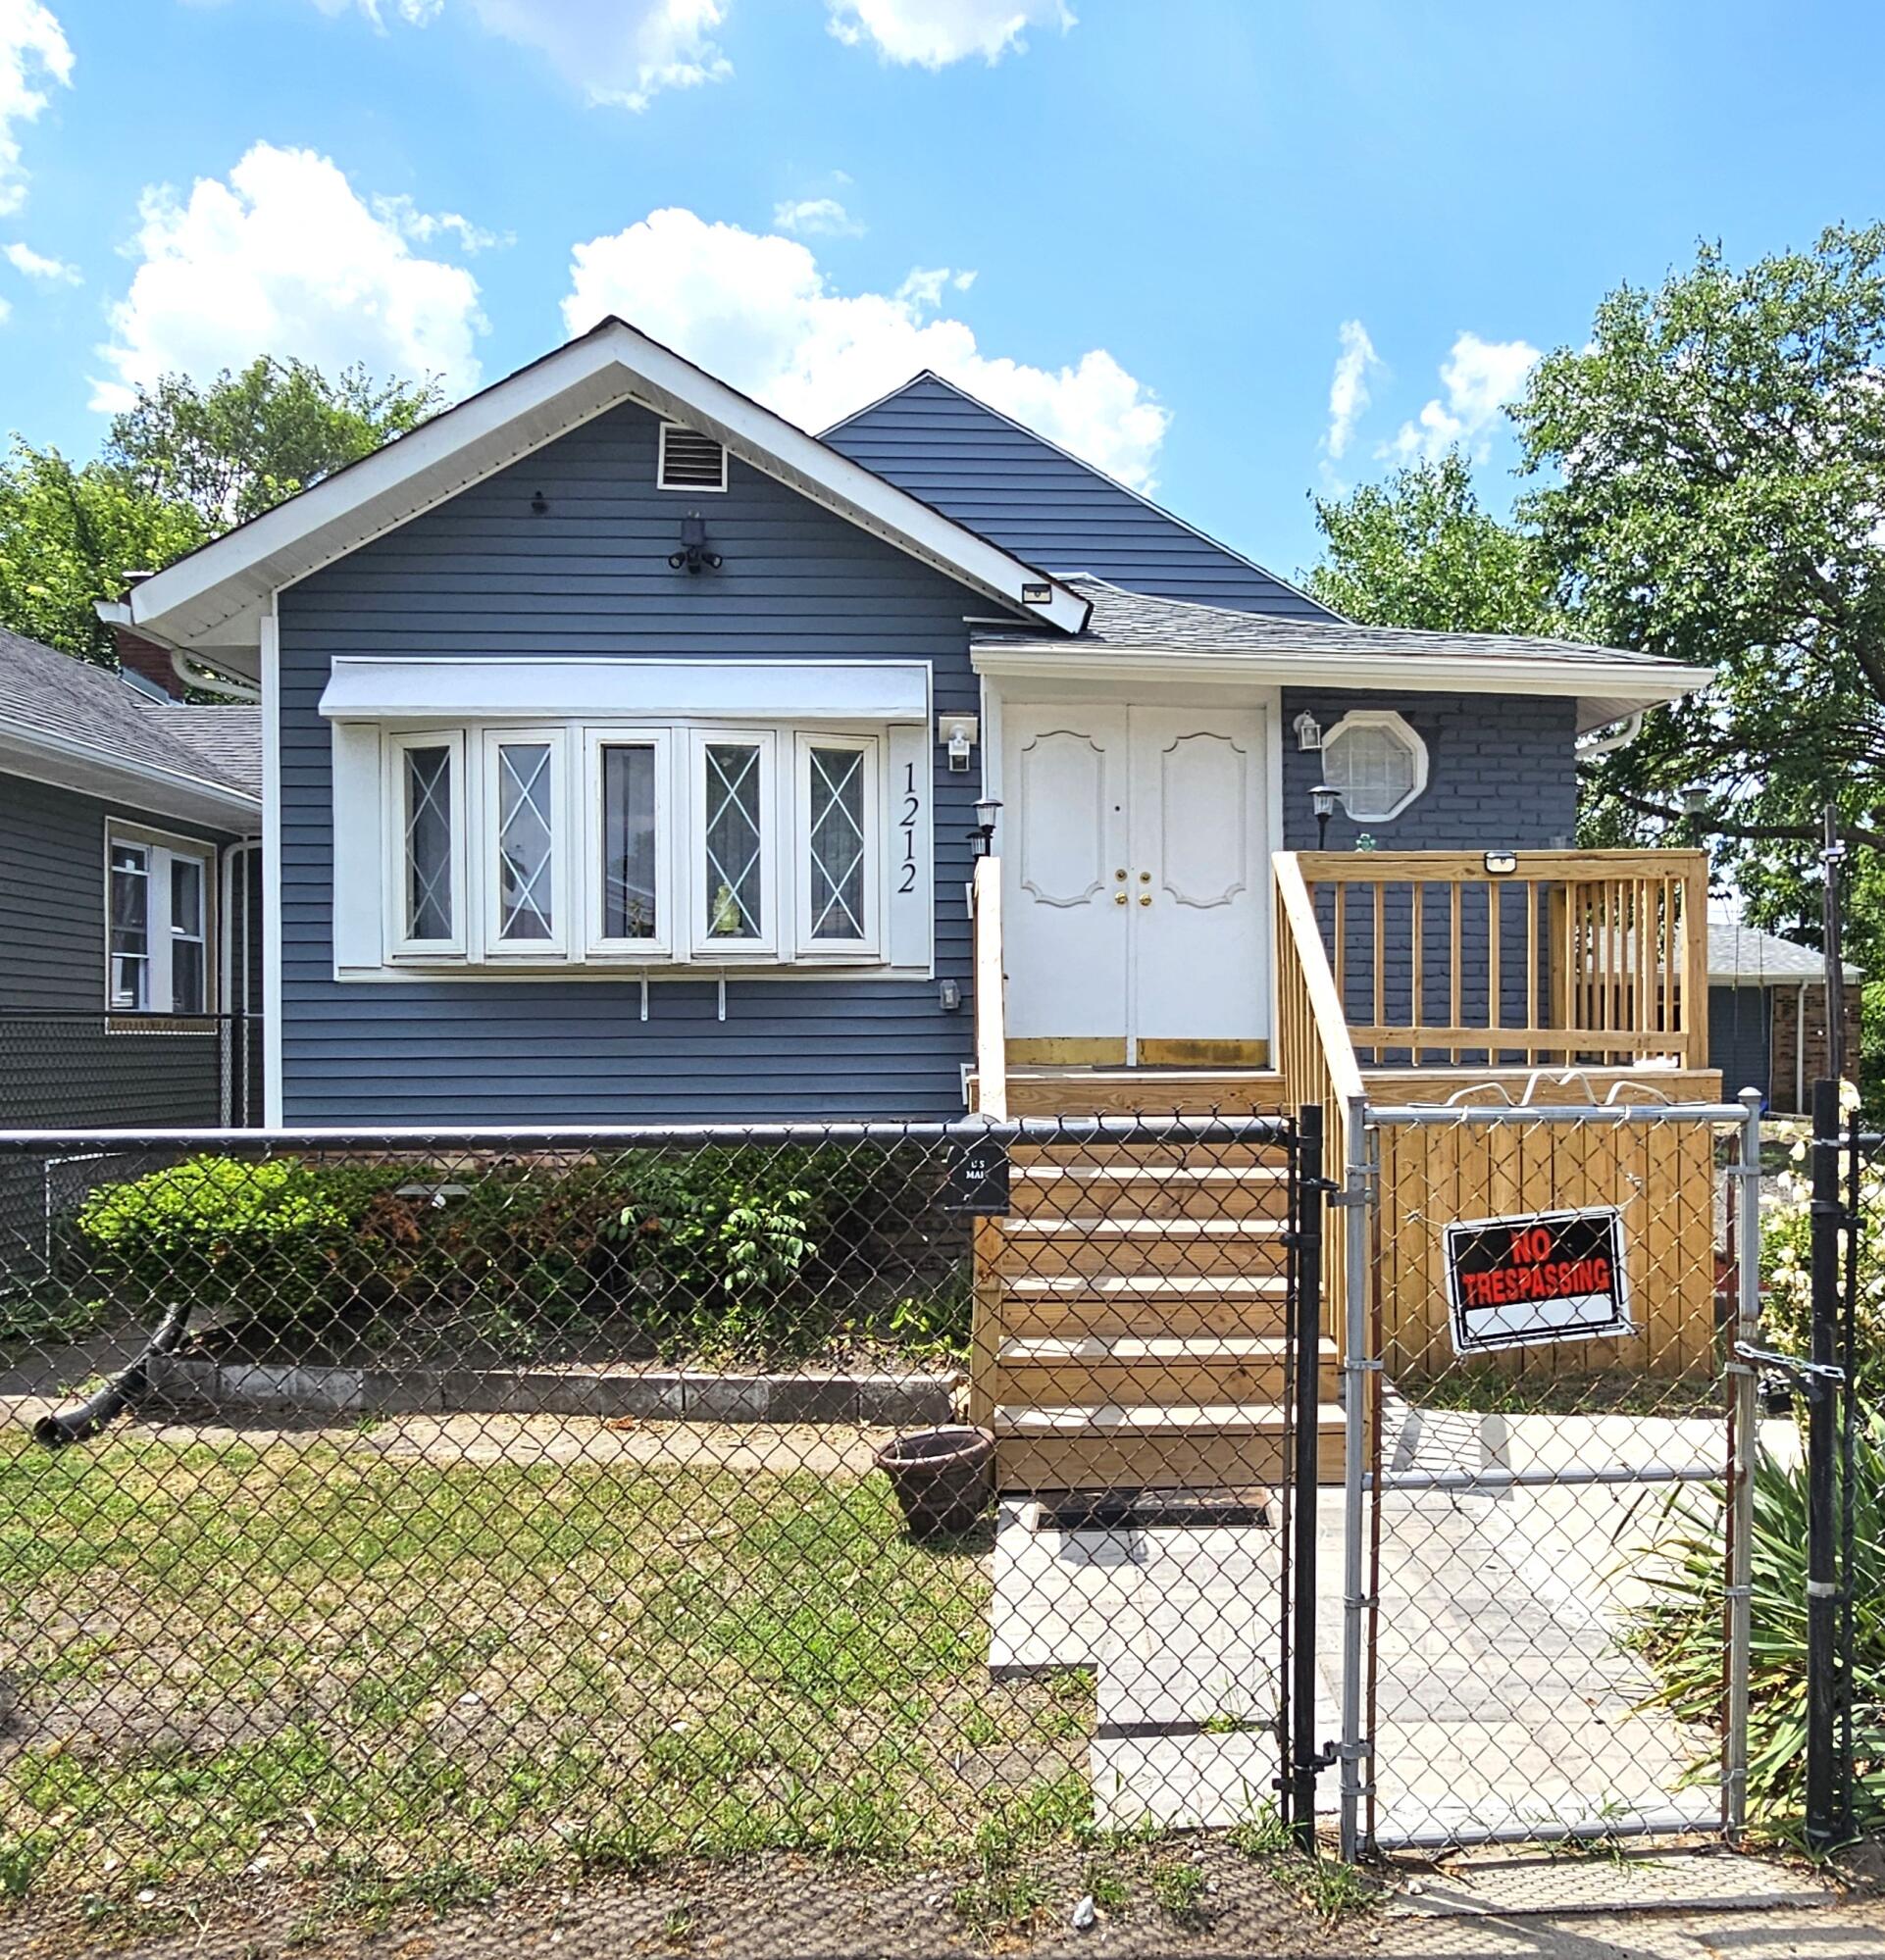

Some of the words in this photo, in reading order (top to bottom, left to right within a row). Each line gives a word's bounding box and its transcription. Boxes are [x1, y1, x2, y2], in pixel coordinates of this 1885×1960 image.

[897, 761, 919, 893] 1212
[966, 1171, 987, 1180] MAI
[1510, 1228, 1551, 1265] NO
[1462, 1257, 1610, 1306] TRESPASSING
